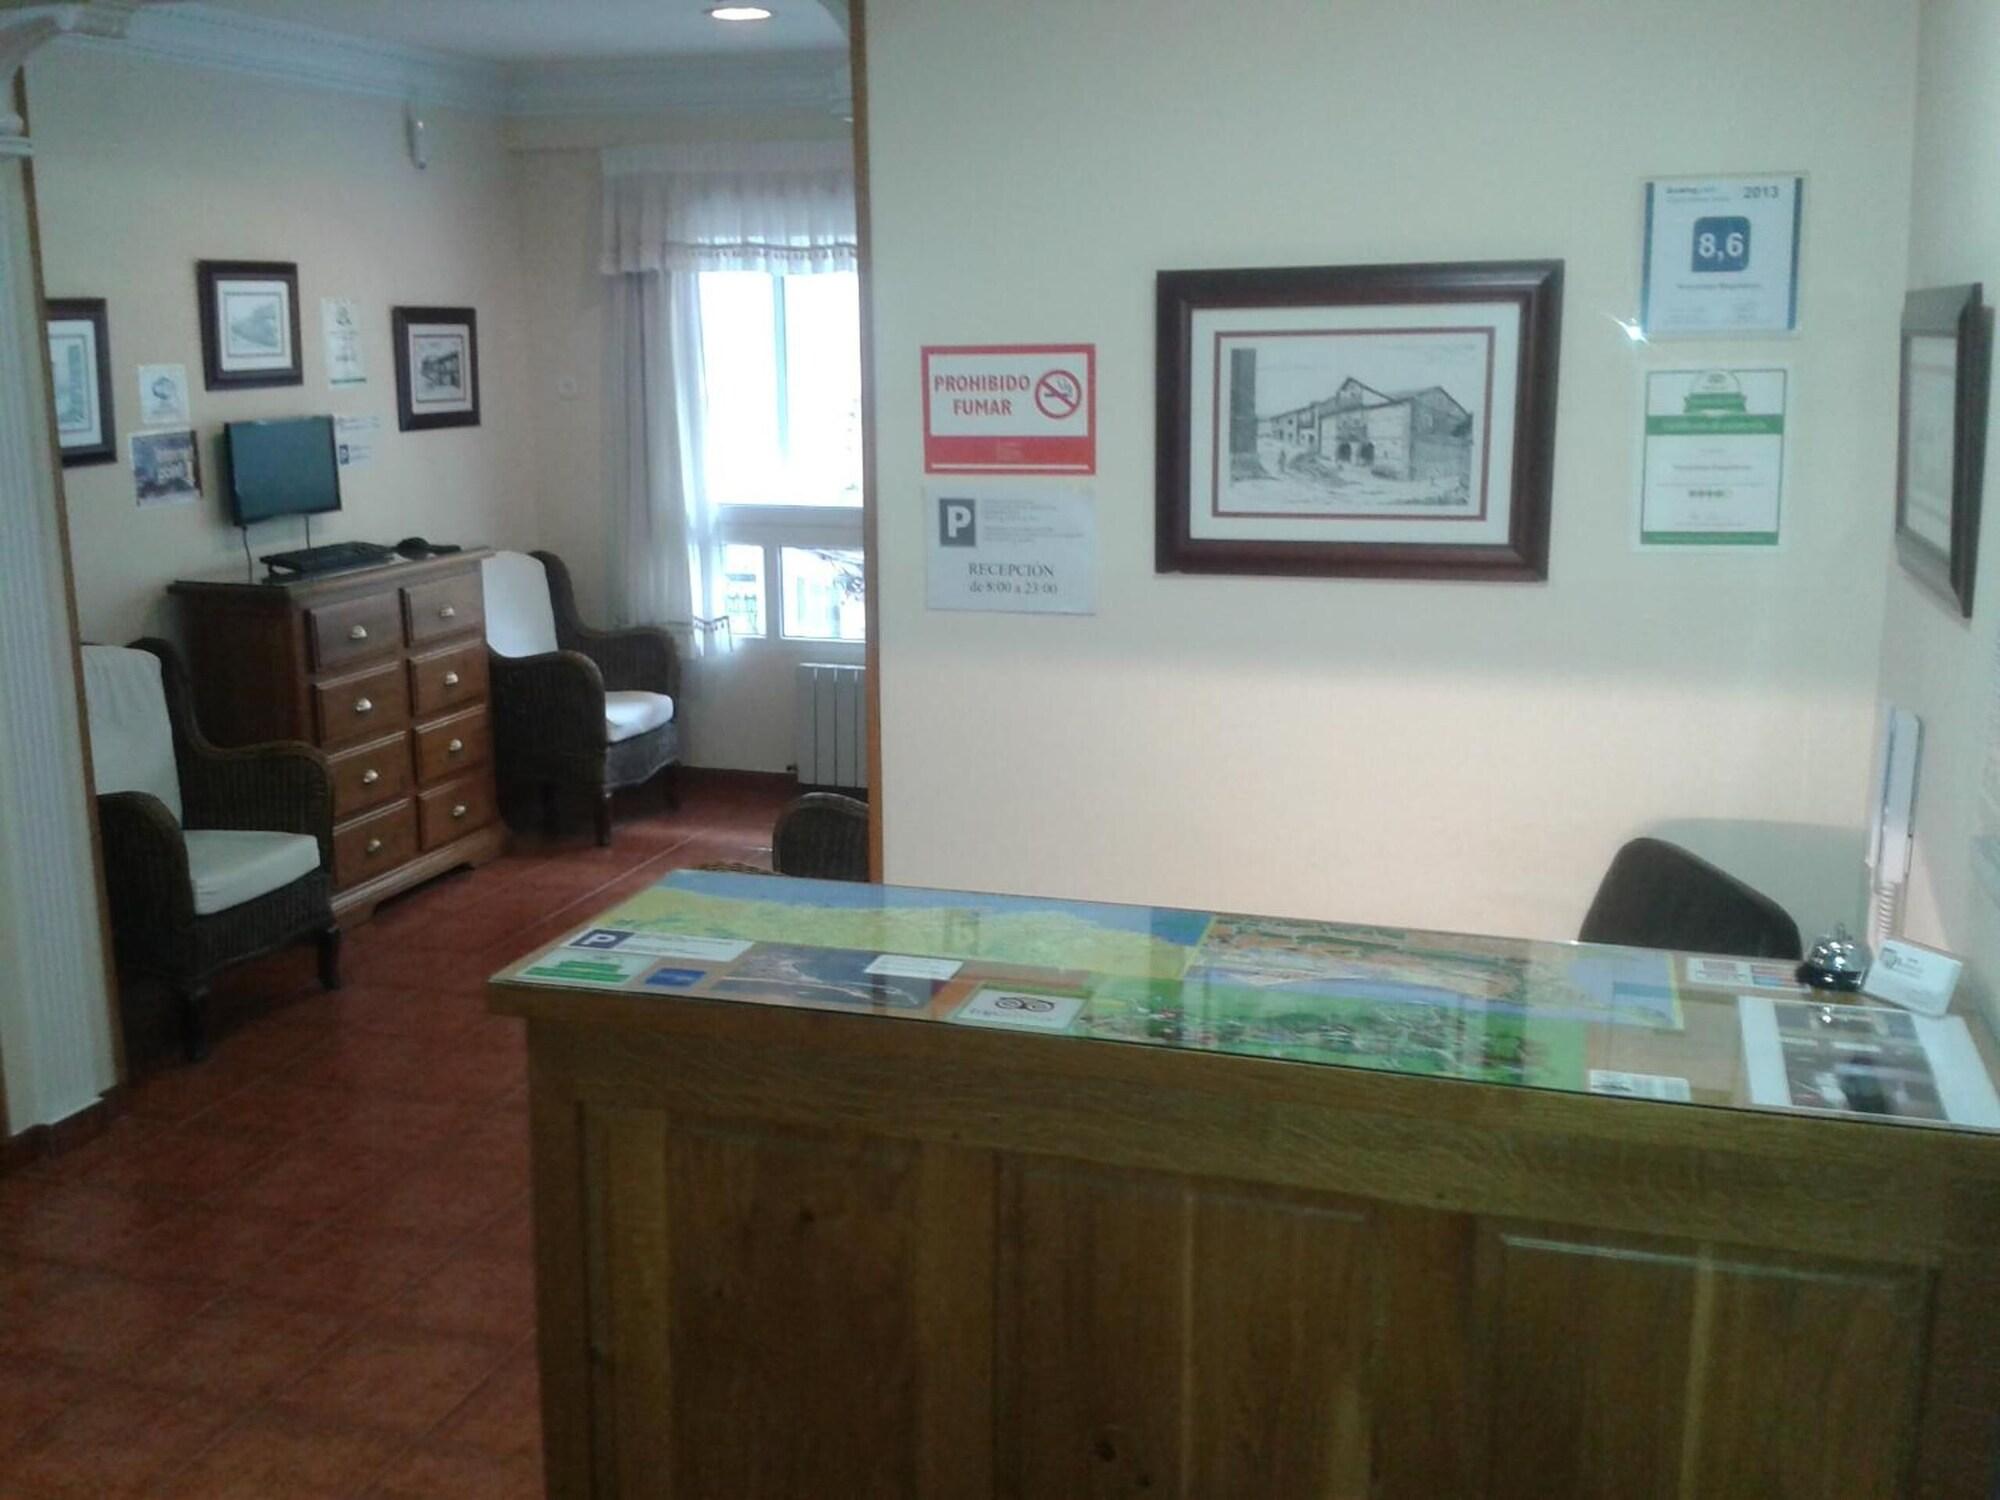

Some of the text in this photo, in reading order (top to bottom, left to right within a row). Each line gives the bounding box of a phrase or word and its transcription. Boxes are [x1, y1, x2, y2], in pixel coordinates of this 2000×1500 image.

[1743, 186, 1779, 199] 2013
[1698, 232, 1744, 262] 8,6
[933, 374, 1031, 393] PROHIBIDO
[953, 398, 1012, 416] FUMAR
[946, 505, 972, 538] P
[969, 580, 982, 593] de
